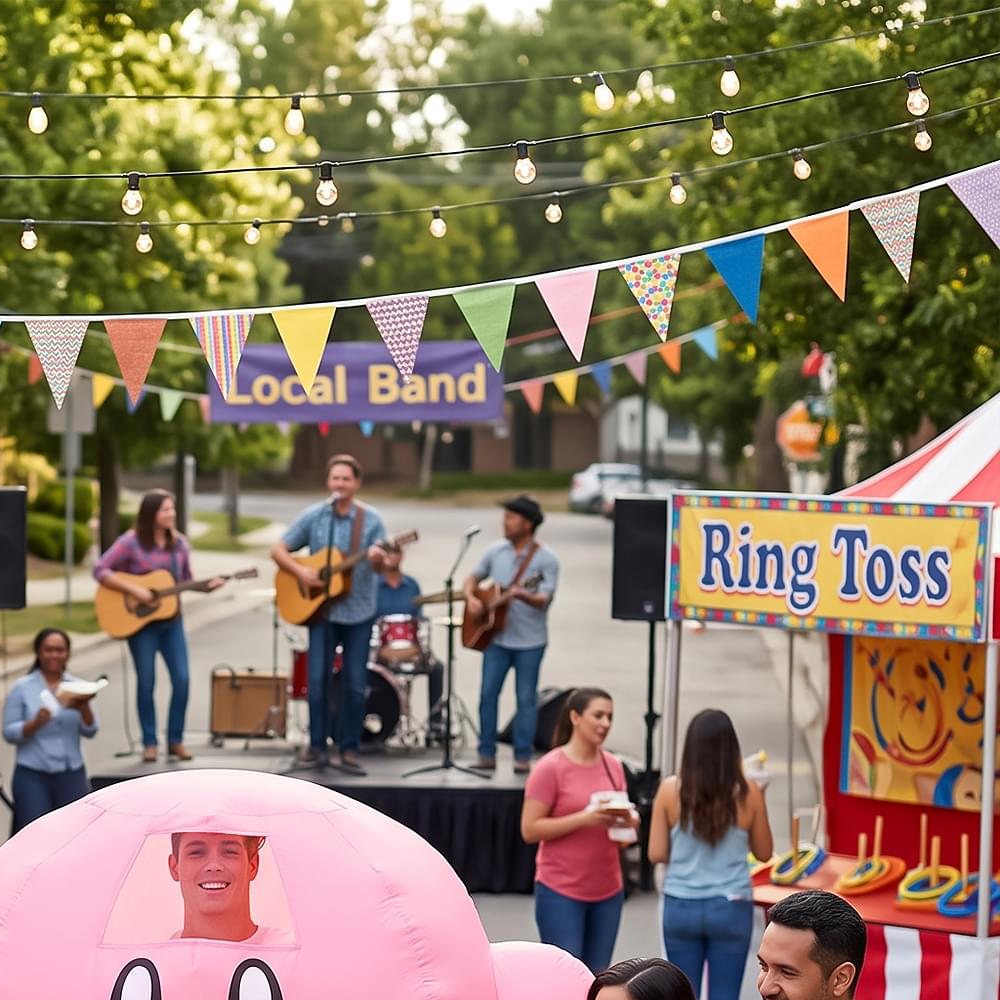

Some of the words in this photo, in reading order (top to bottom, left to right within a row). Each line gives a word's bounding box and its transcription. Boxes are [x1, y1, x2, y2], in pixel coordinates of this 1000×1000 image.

[225, 364, 348, 405] Local
[368, 362, 487, 405] Band
[699, 521, 818, 613] Ring
[832, 526, 951, 603] Toss
